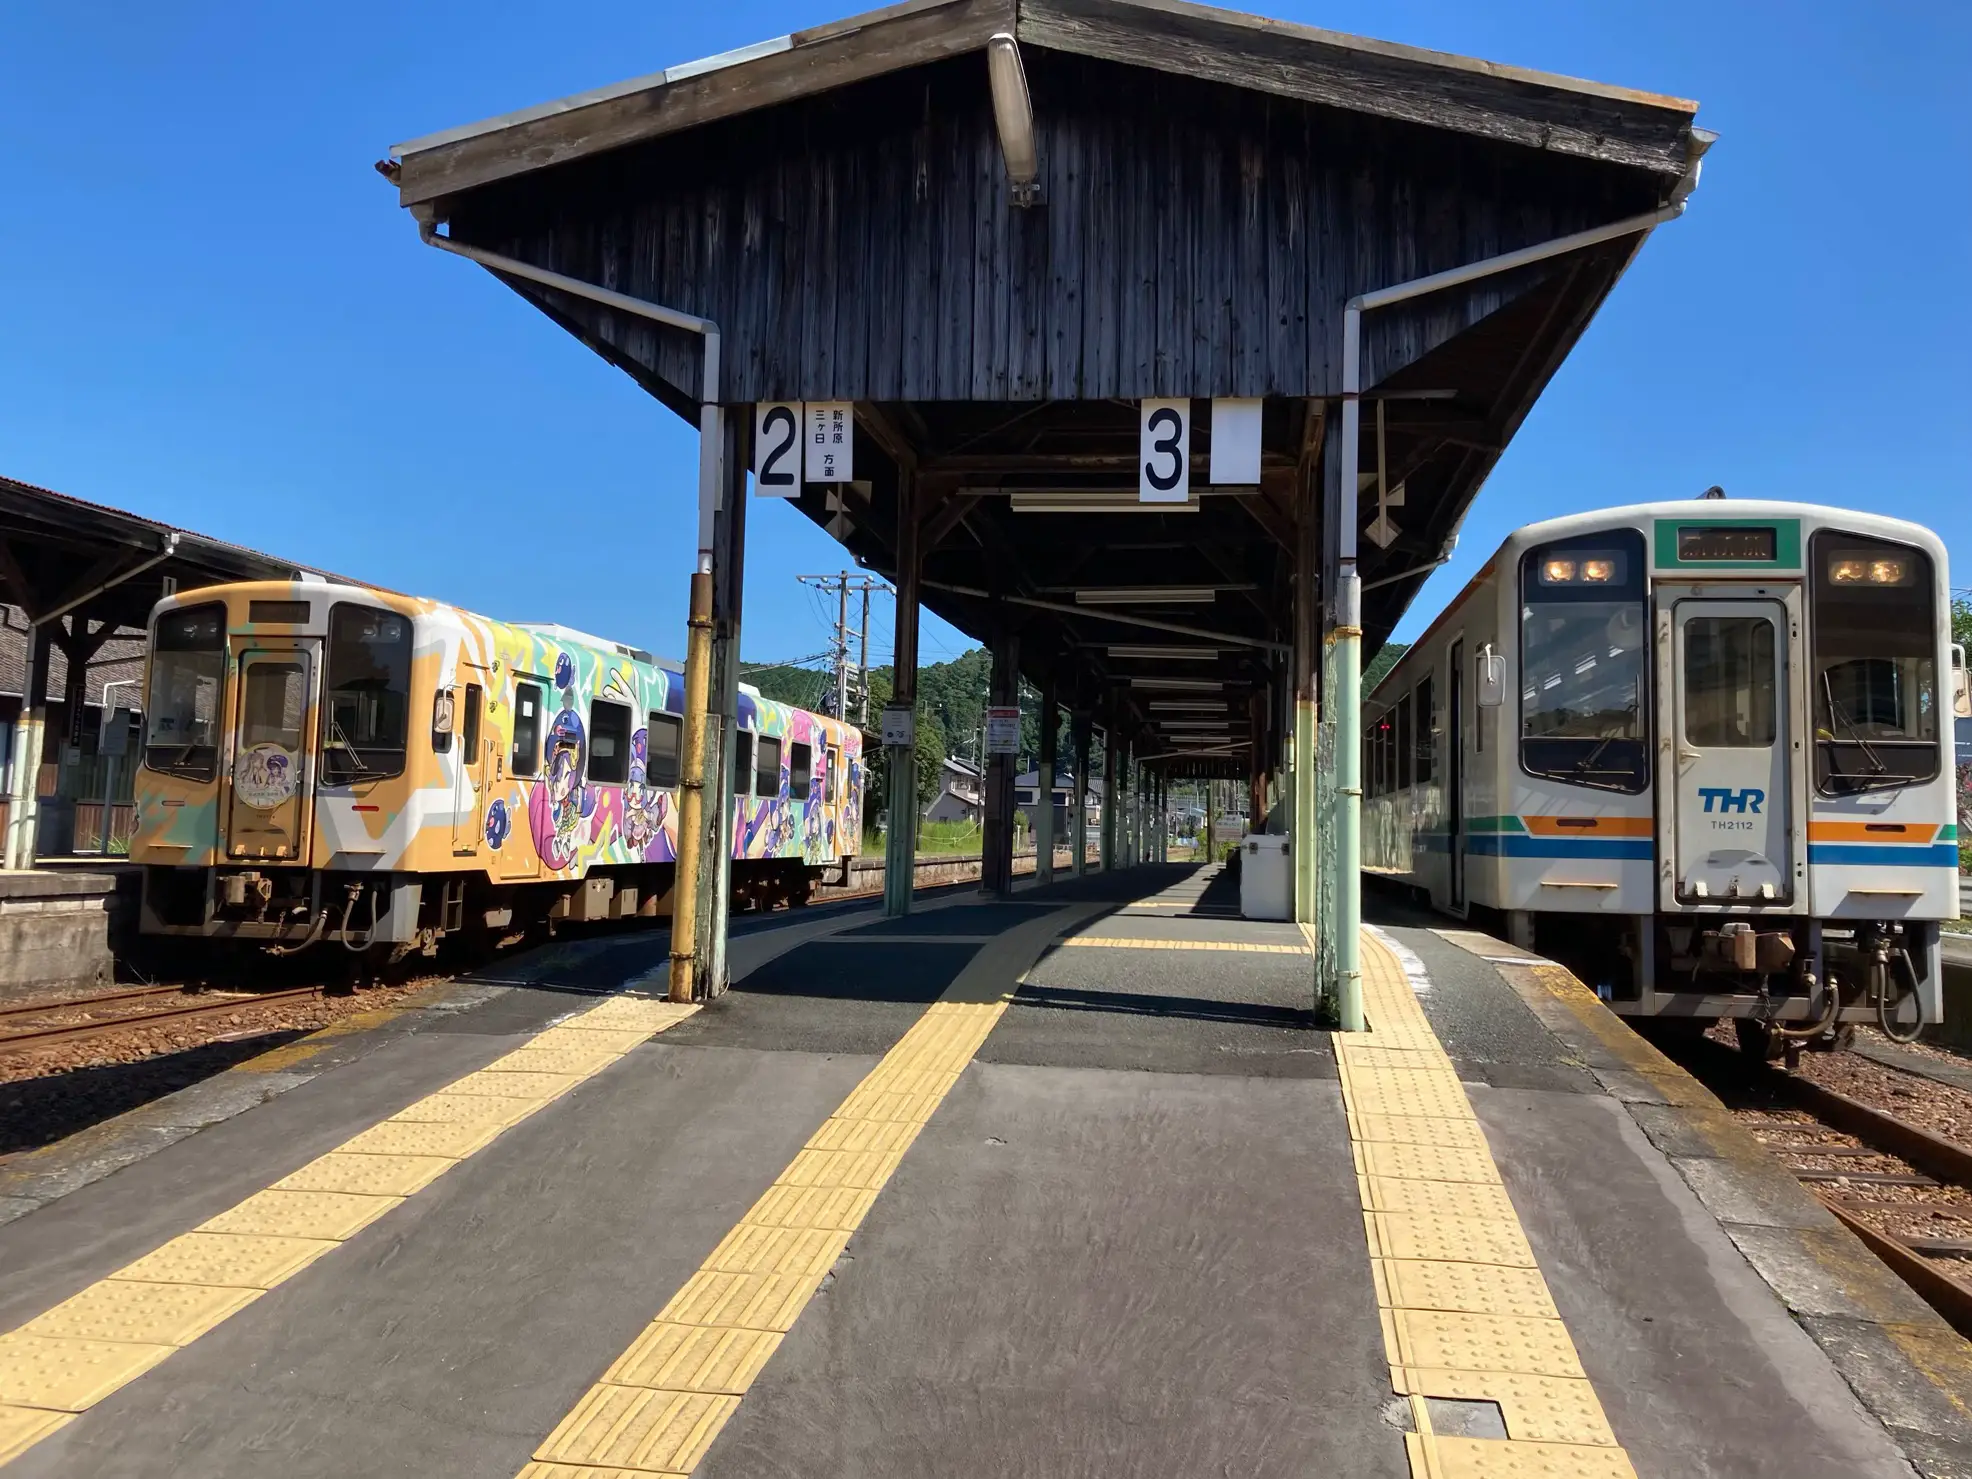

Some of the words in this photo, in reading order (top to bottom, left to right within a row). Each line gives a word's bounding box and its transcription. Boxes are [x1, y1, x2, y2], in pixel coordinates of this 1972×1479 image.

[833, 410, 843, 444] 新所原
[760, 406, 796, 485] 2
[1145, 407, 1182, 490] 3
[824, 454, 834, 477] 方面
[1698, 788, 1765, 813] THR
[1711, 821, 1753, 830] TH2112
